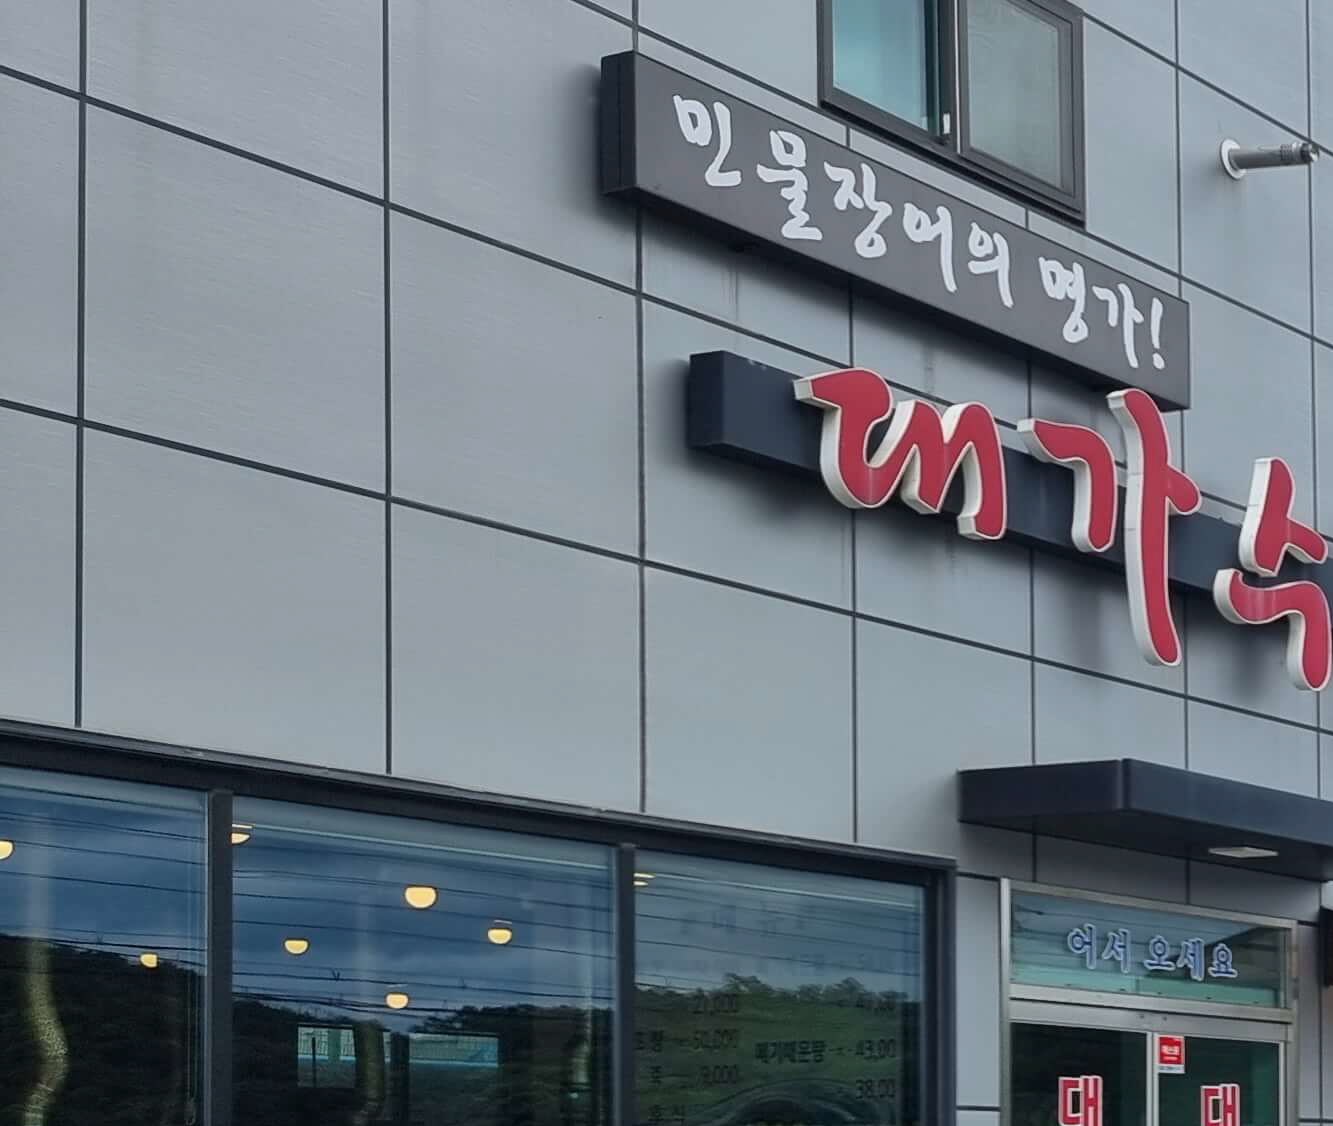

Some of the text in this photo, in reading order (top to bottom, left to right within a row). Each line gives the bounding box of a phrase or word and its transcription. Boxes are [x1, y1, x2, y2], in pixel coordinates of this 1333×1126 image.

[673, 95, 1165, 369] 민물장어의 명가!
[1067, 923, 1239, 981] 어서 오세요
